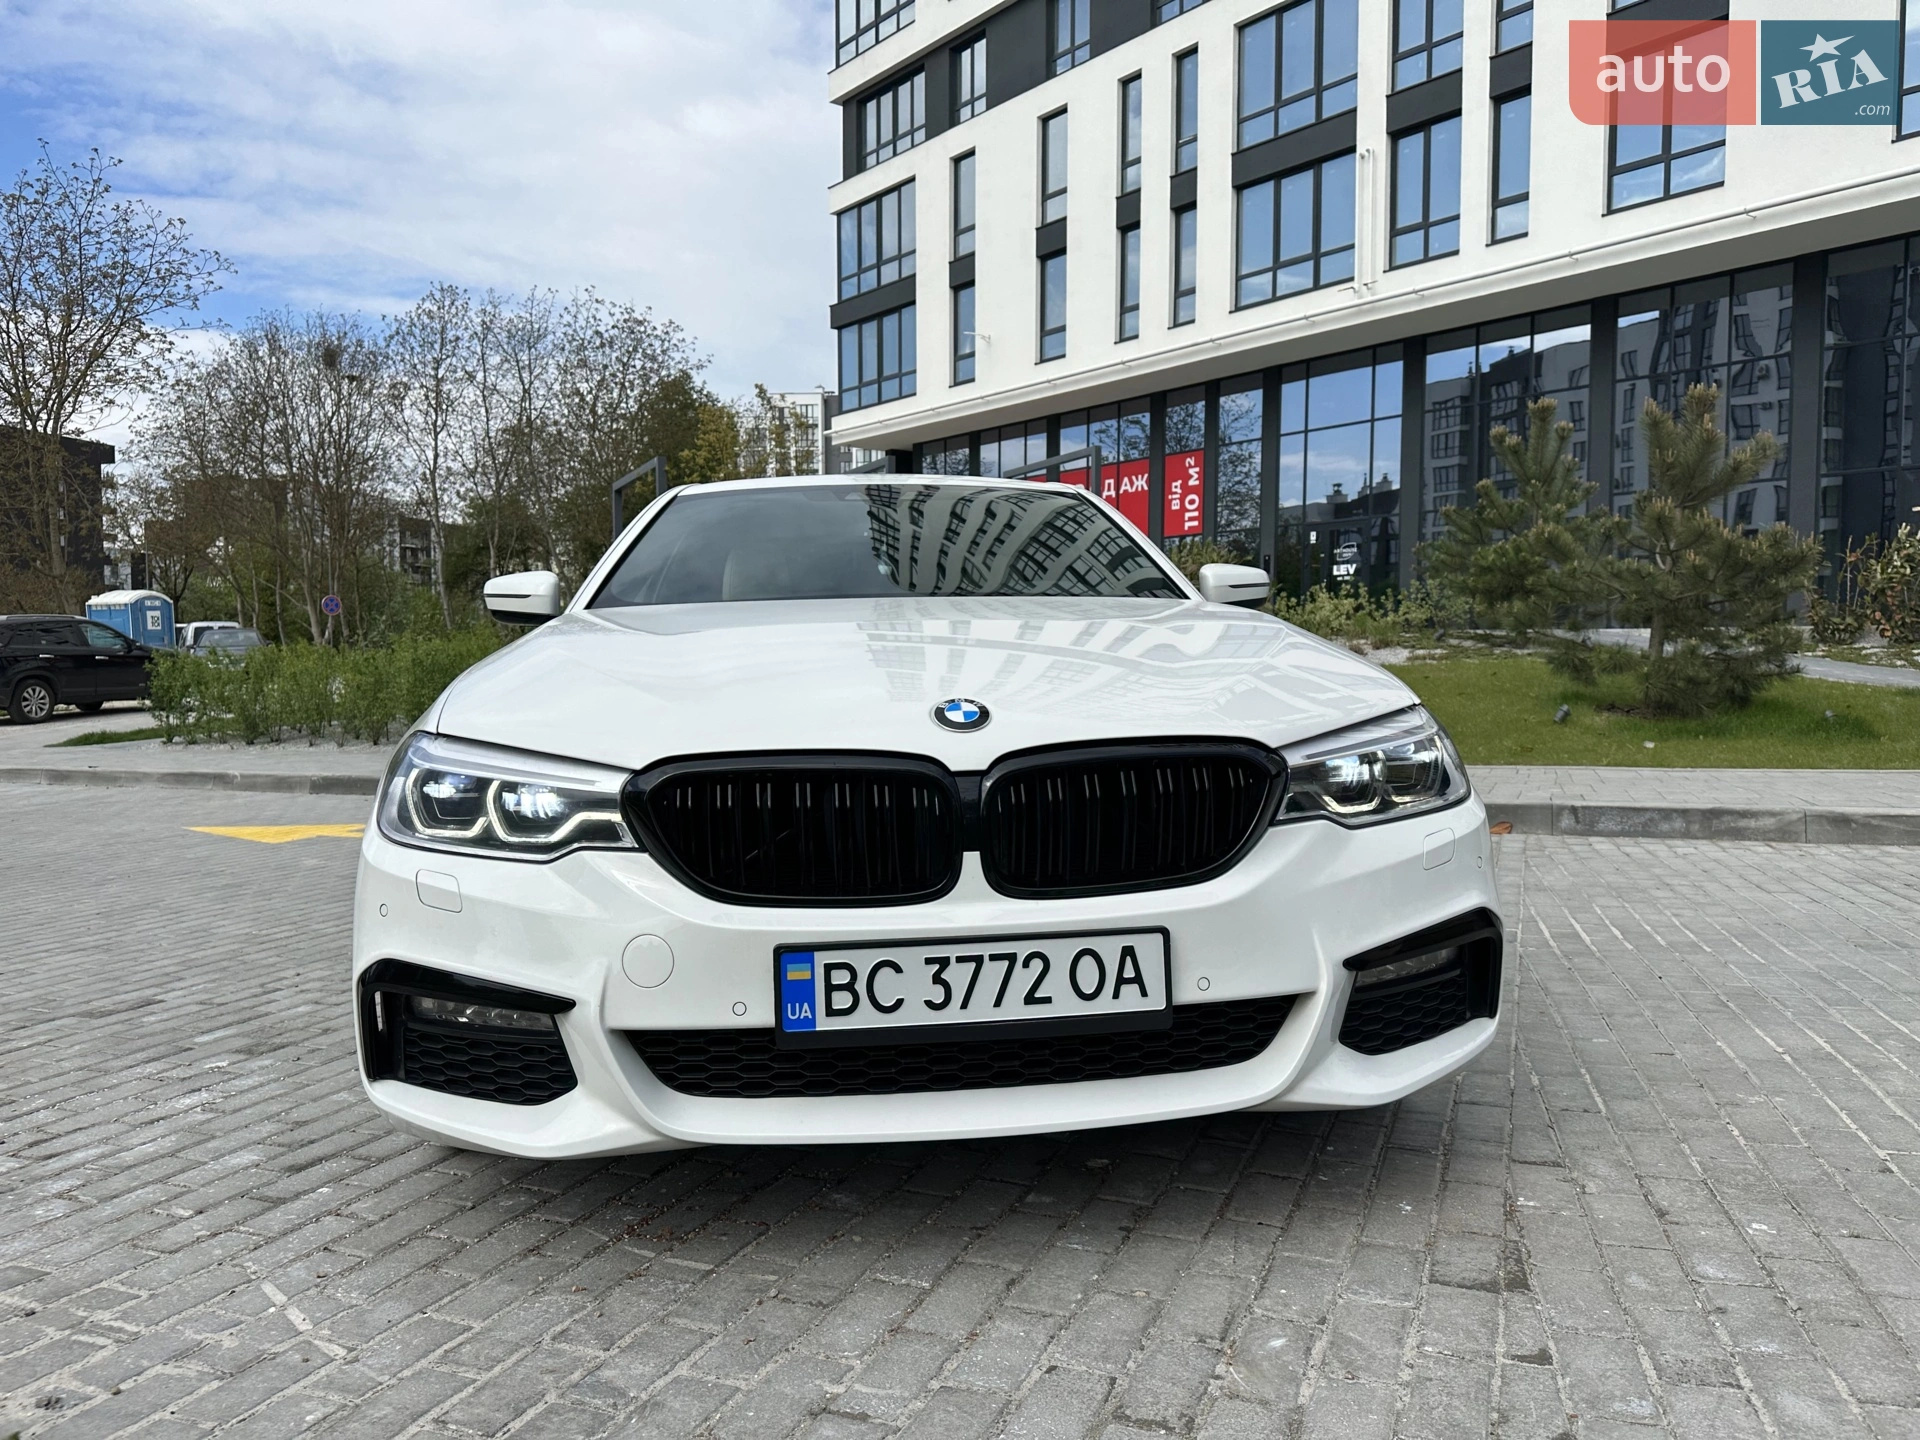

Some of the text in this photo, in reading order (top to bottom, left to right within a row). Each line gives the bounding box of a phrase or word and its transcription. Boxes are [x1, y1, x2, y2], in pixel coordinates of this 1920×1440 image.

[1075, 473, 1149, 499] ДАЖ
[1184, 494, 1200, 530] 110
[1333, 564, 1357, 575] LEV
[823, 945, 1149, 1017] BC 3772 OA
[787, 1003, 812, 1019] UA
